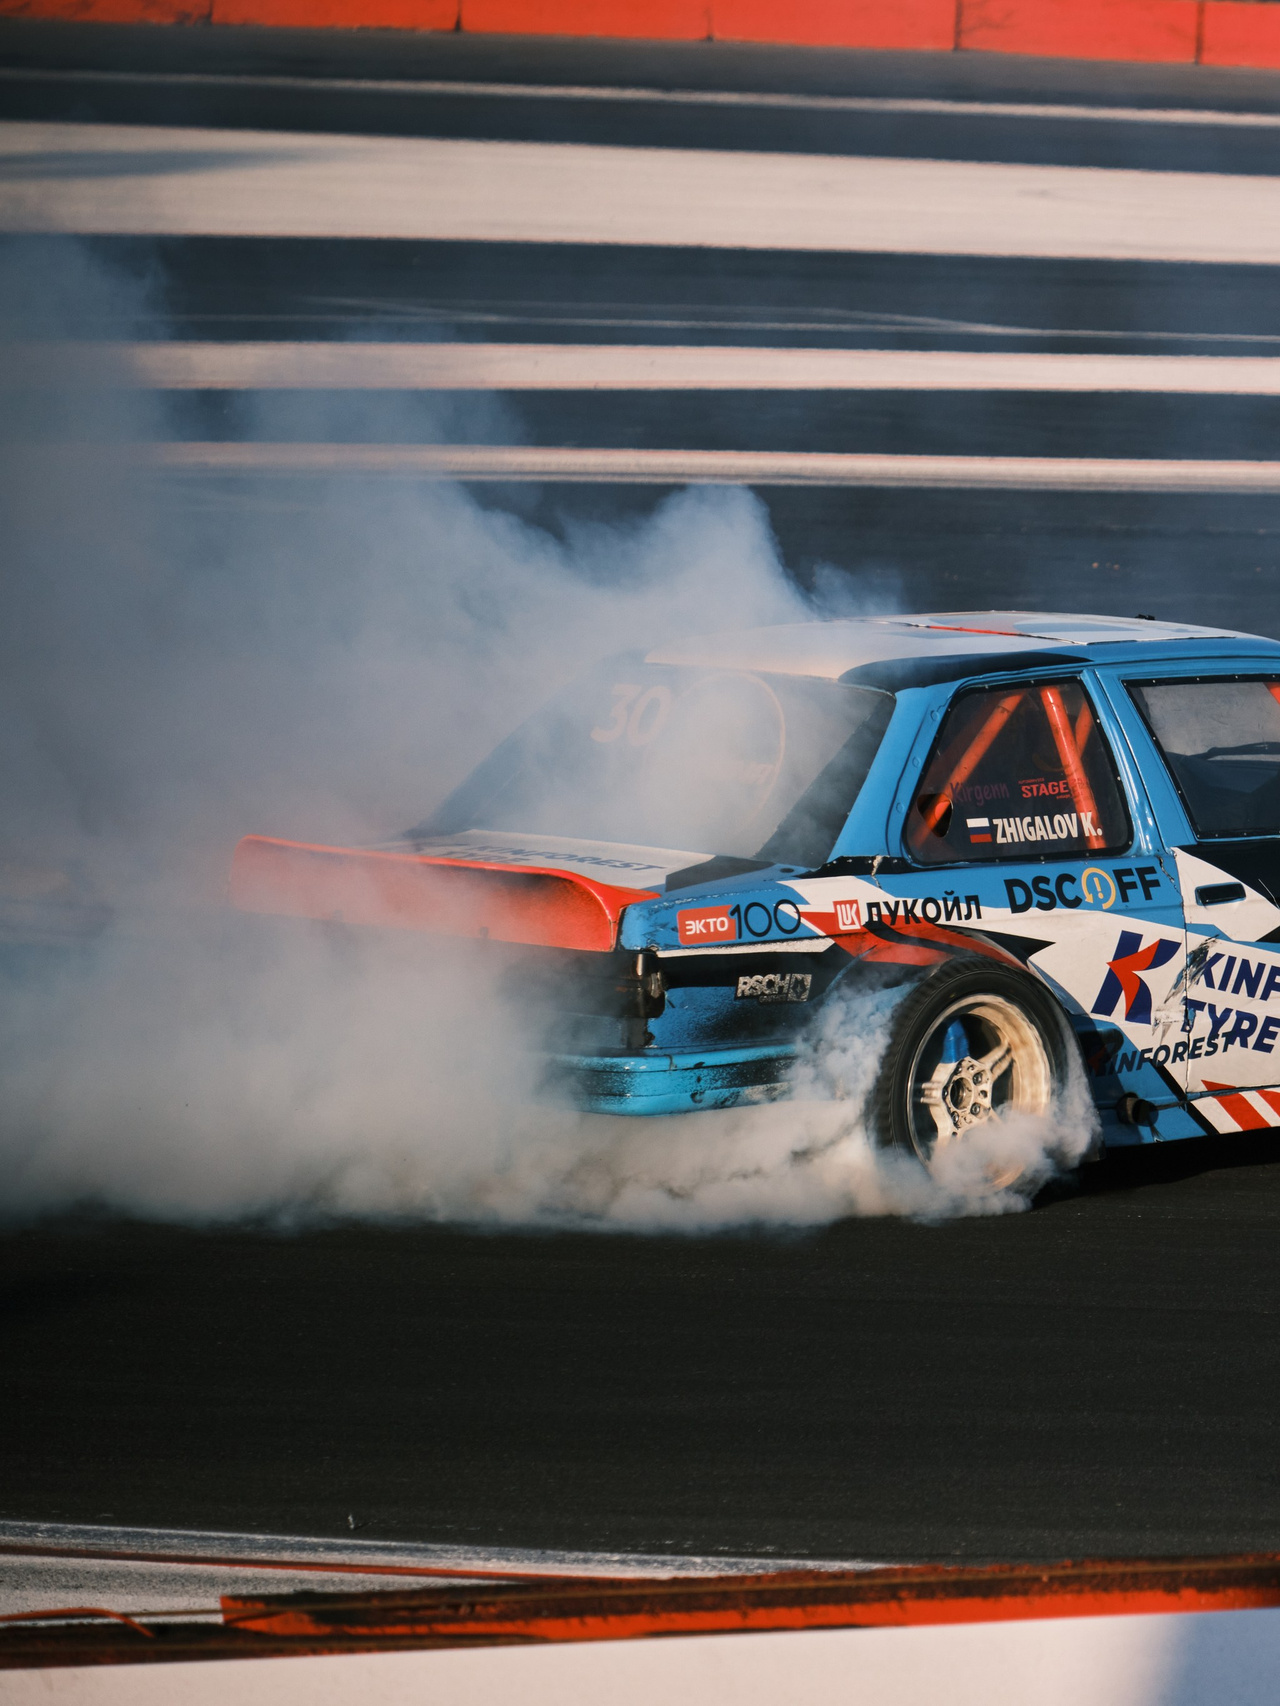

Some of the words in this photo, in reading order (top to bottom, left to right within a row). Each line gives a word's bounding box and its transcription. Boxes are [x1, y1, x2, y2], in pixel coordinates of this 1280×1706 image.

[590, 683, 672, 746] 30
[1021, 780, 1069, 798] STAGE
[992, 813, 1078, 844] ZHIGALOV
[1079, 811, 1103, 837] K.
[685, 917, 729, 935] ЭКТО
[729, 899, 802, 940] 100
[865, 890, 982, 926] ЛУКОЙЛ
